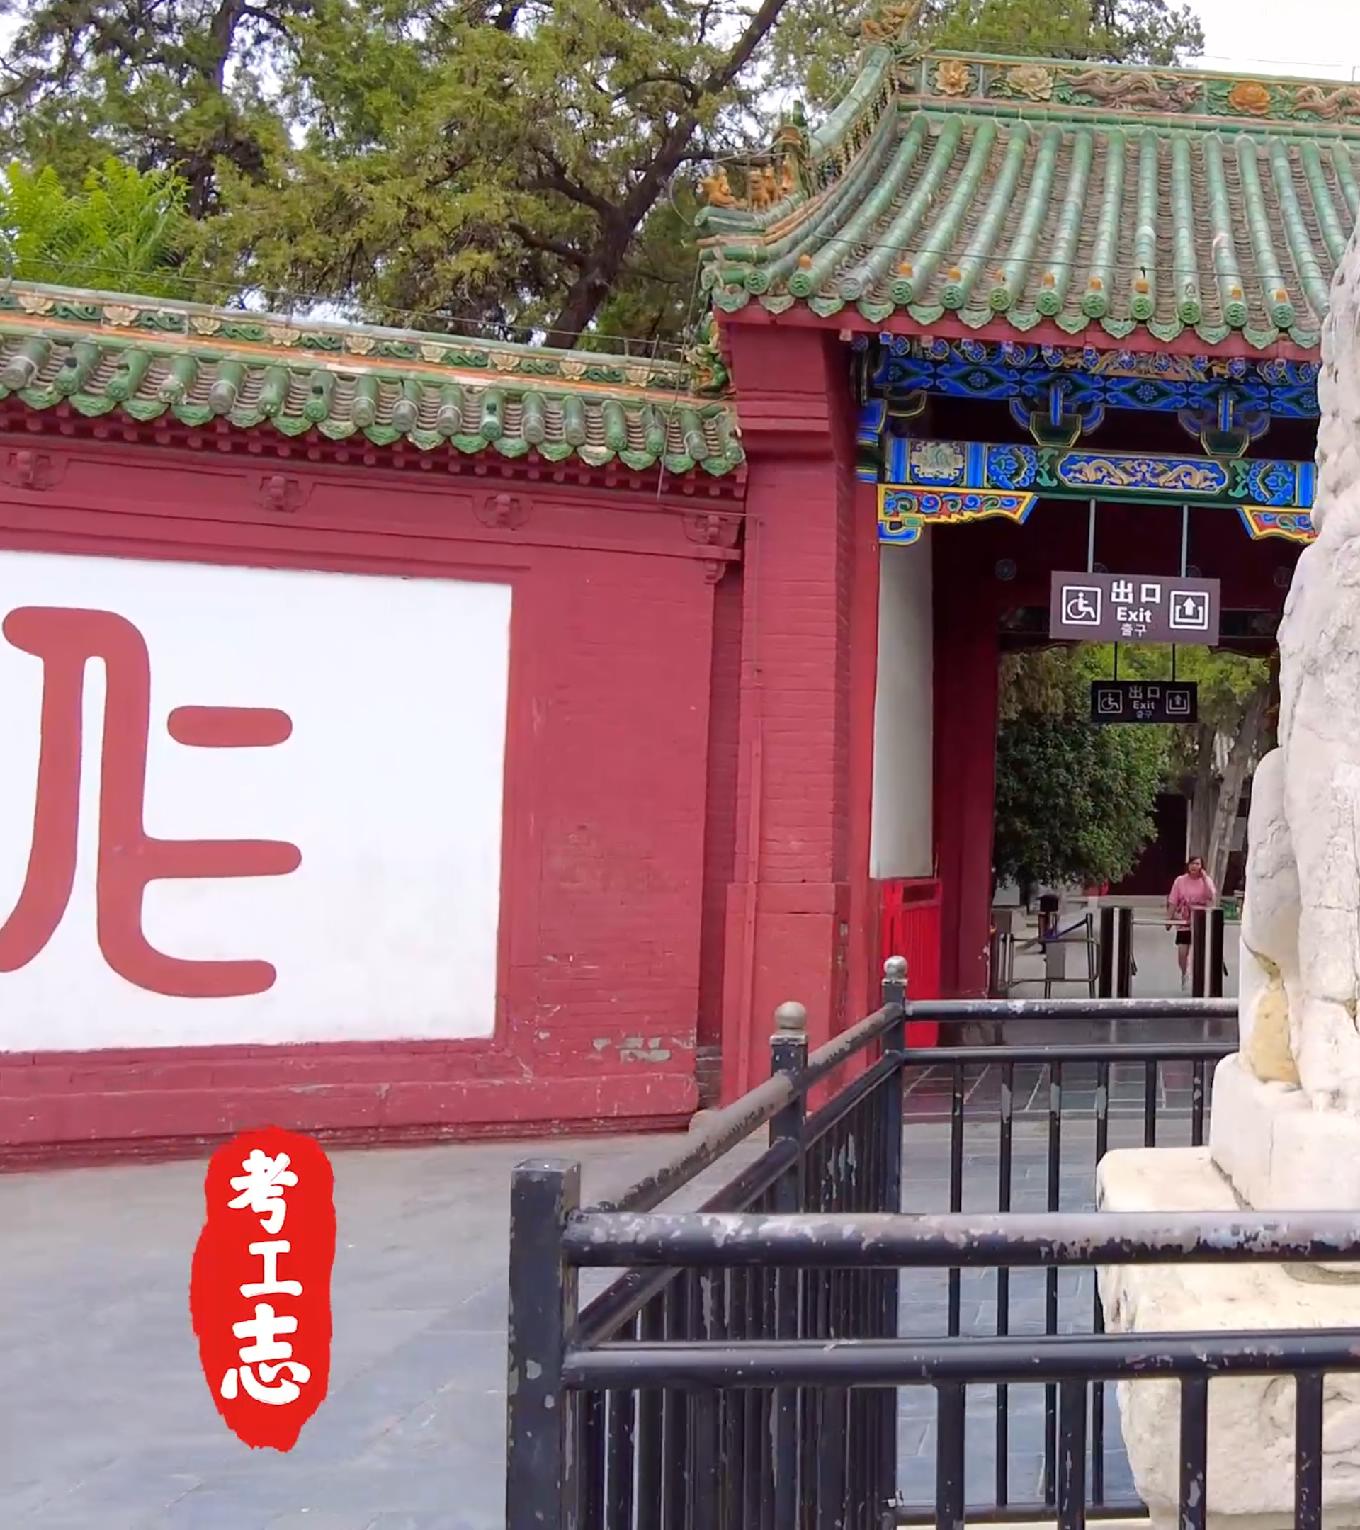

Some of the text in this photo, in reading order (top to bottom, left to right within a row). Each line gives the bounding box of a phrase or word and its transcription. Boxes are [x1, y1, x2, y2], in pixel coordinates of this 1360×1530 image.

[1111, 580, 1161, 604] 出口
[1117, 606, 1152, 623] Exit
[1128, 685, 1161, 699] 出口
[1133, 700, 1155, 710] Exit
